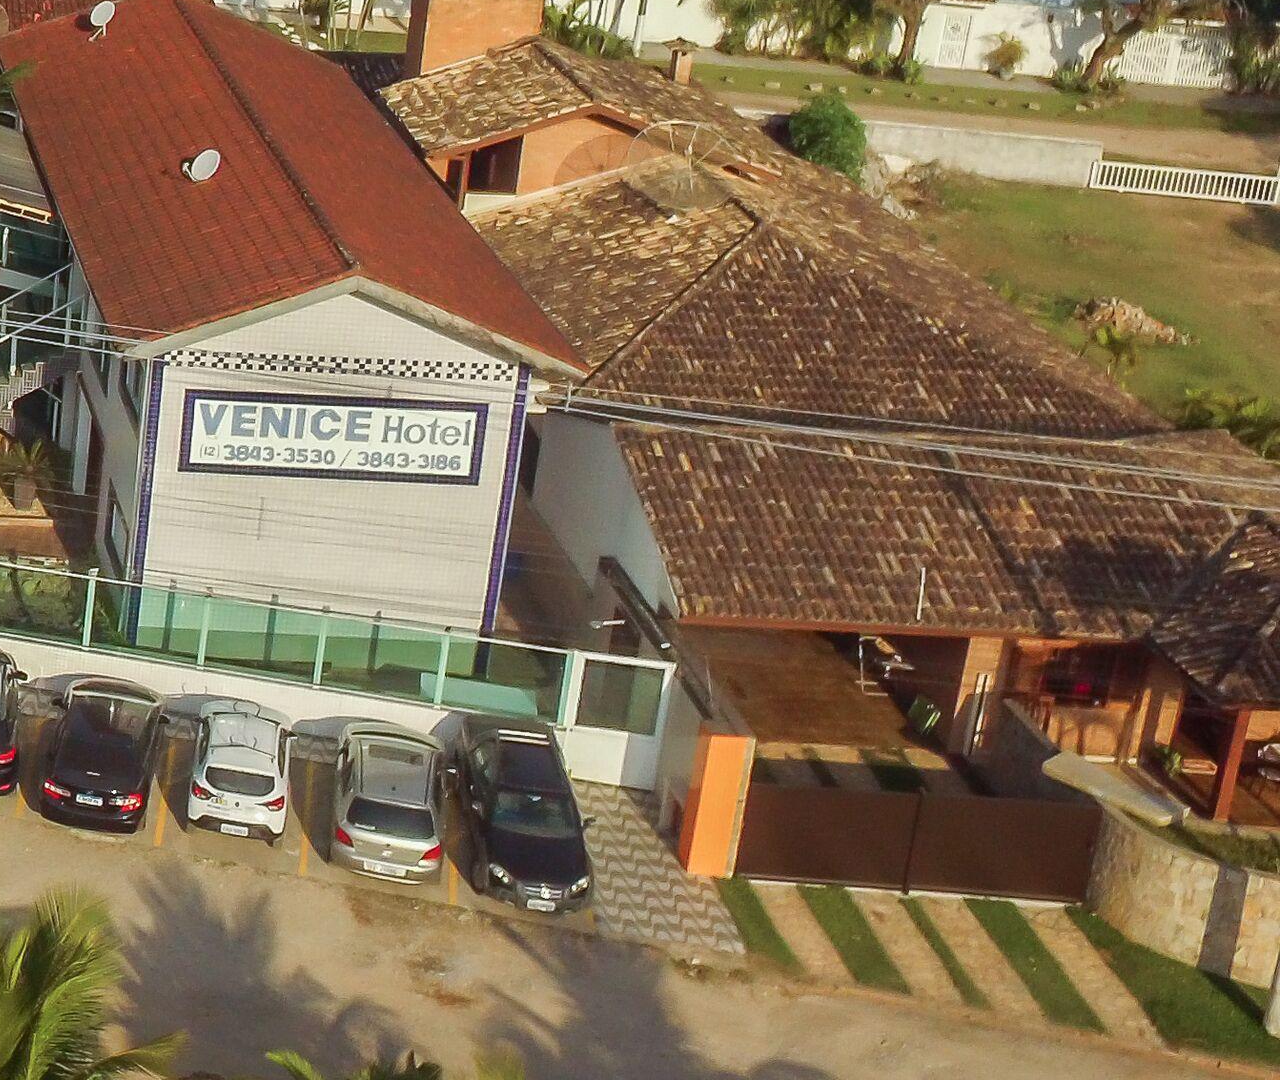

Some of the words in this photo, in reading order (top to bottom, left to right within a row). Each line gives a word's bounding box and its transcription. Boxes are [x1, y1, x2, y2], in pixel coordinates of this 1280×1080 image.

[200, 403, 372, 442] VENICE
[381, 415, 471, 446] Hotel
[223, 444, 335, 465] 3843-3530
[357, 451, 461, 471] 3843-3186
